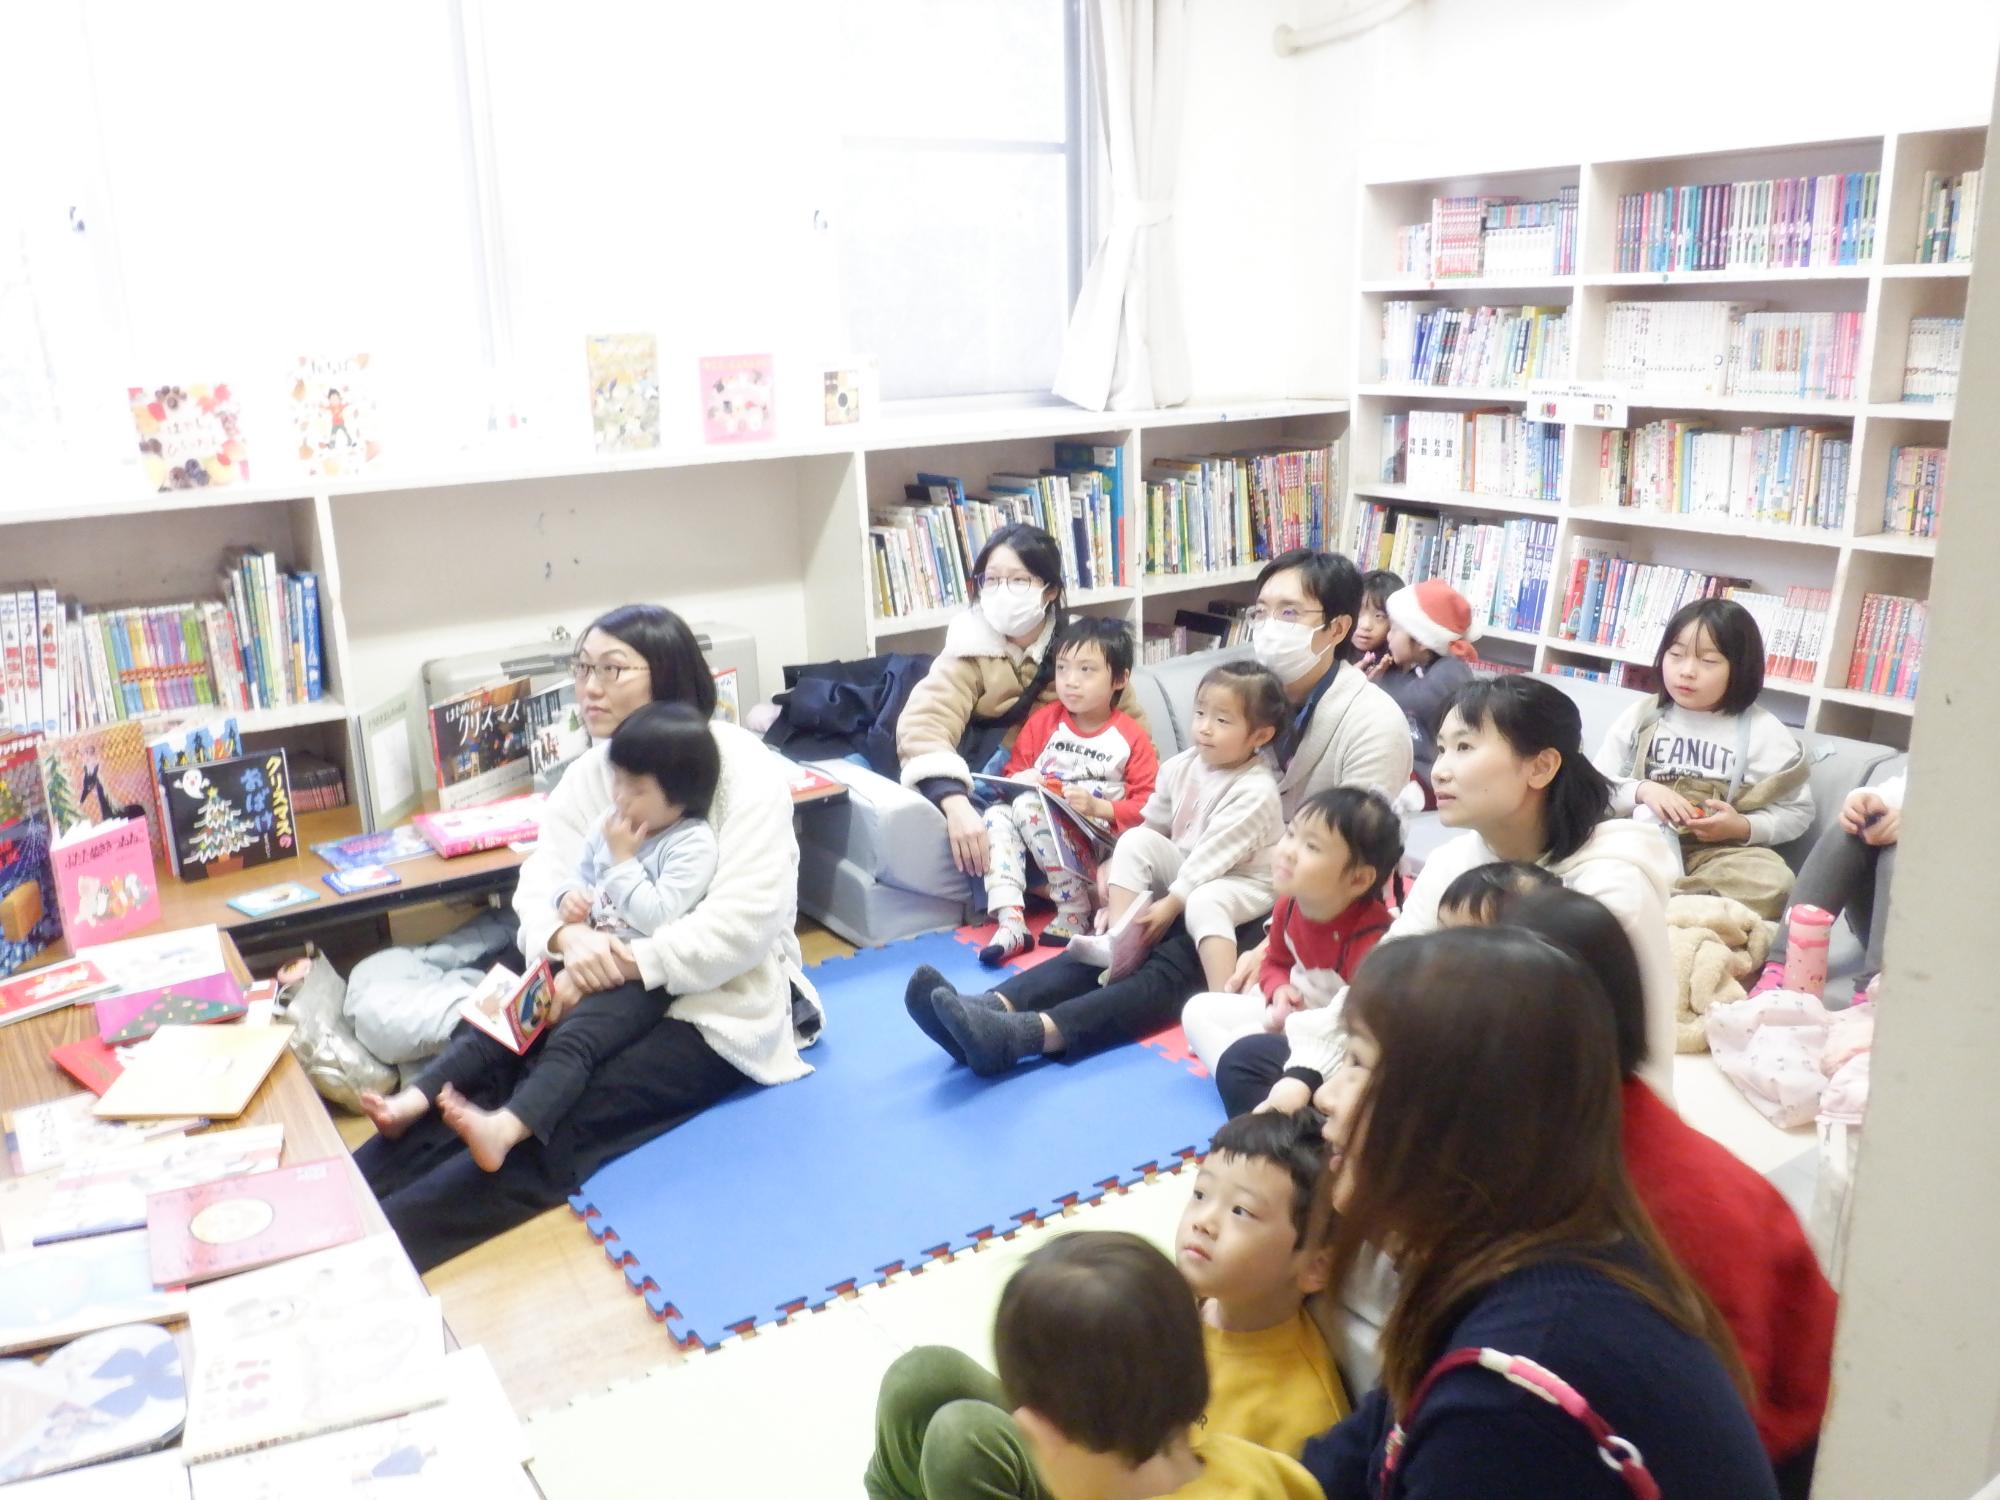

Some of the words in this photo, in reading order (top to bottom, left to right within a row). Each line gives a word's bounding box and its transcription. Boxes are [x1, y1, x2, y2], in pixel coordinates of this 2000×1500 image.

[458, 699, 520, 747] クリスマス
[1648, 736, 1736, 775] EANUT
[240, 767, 273, 833] おばけ
[265, 755, 293, 849] クリスマスの
